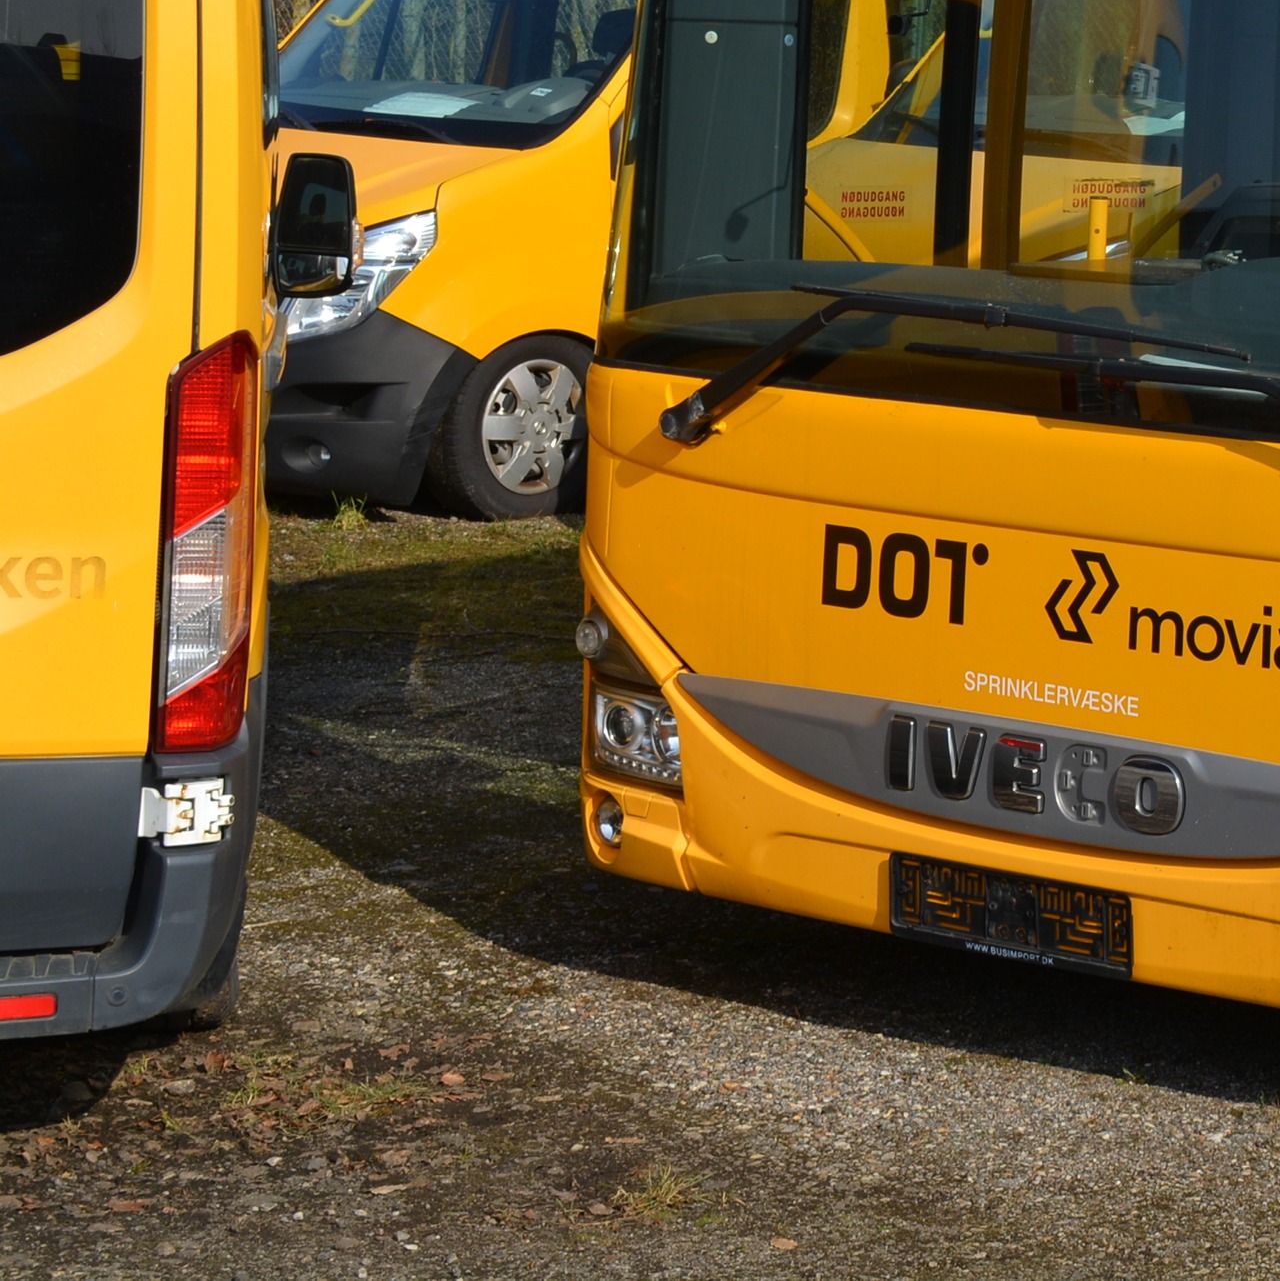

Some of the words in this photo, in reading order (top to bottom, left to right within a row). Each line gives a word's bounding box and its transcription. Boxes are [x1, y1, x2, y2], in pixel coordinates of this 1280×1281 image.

[841, 190, 905, 204] NØDUDGANG
[1072, 182, 1146, 195] NØDUDGANG
[821, 523, 969, 626] DOT
[963, 670, 1140, 718] SPRINKLERVÆSKE
[889, 714, 1187, 836] IVECO
[965, 940, 1055, 966] WWW.BUSIMPORTDK
